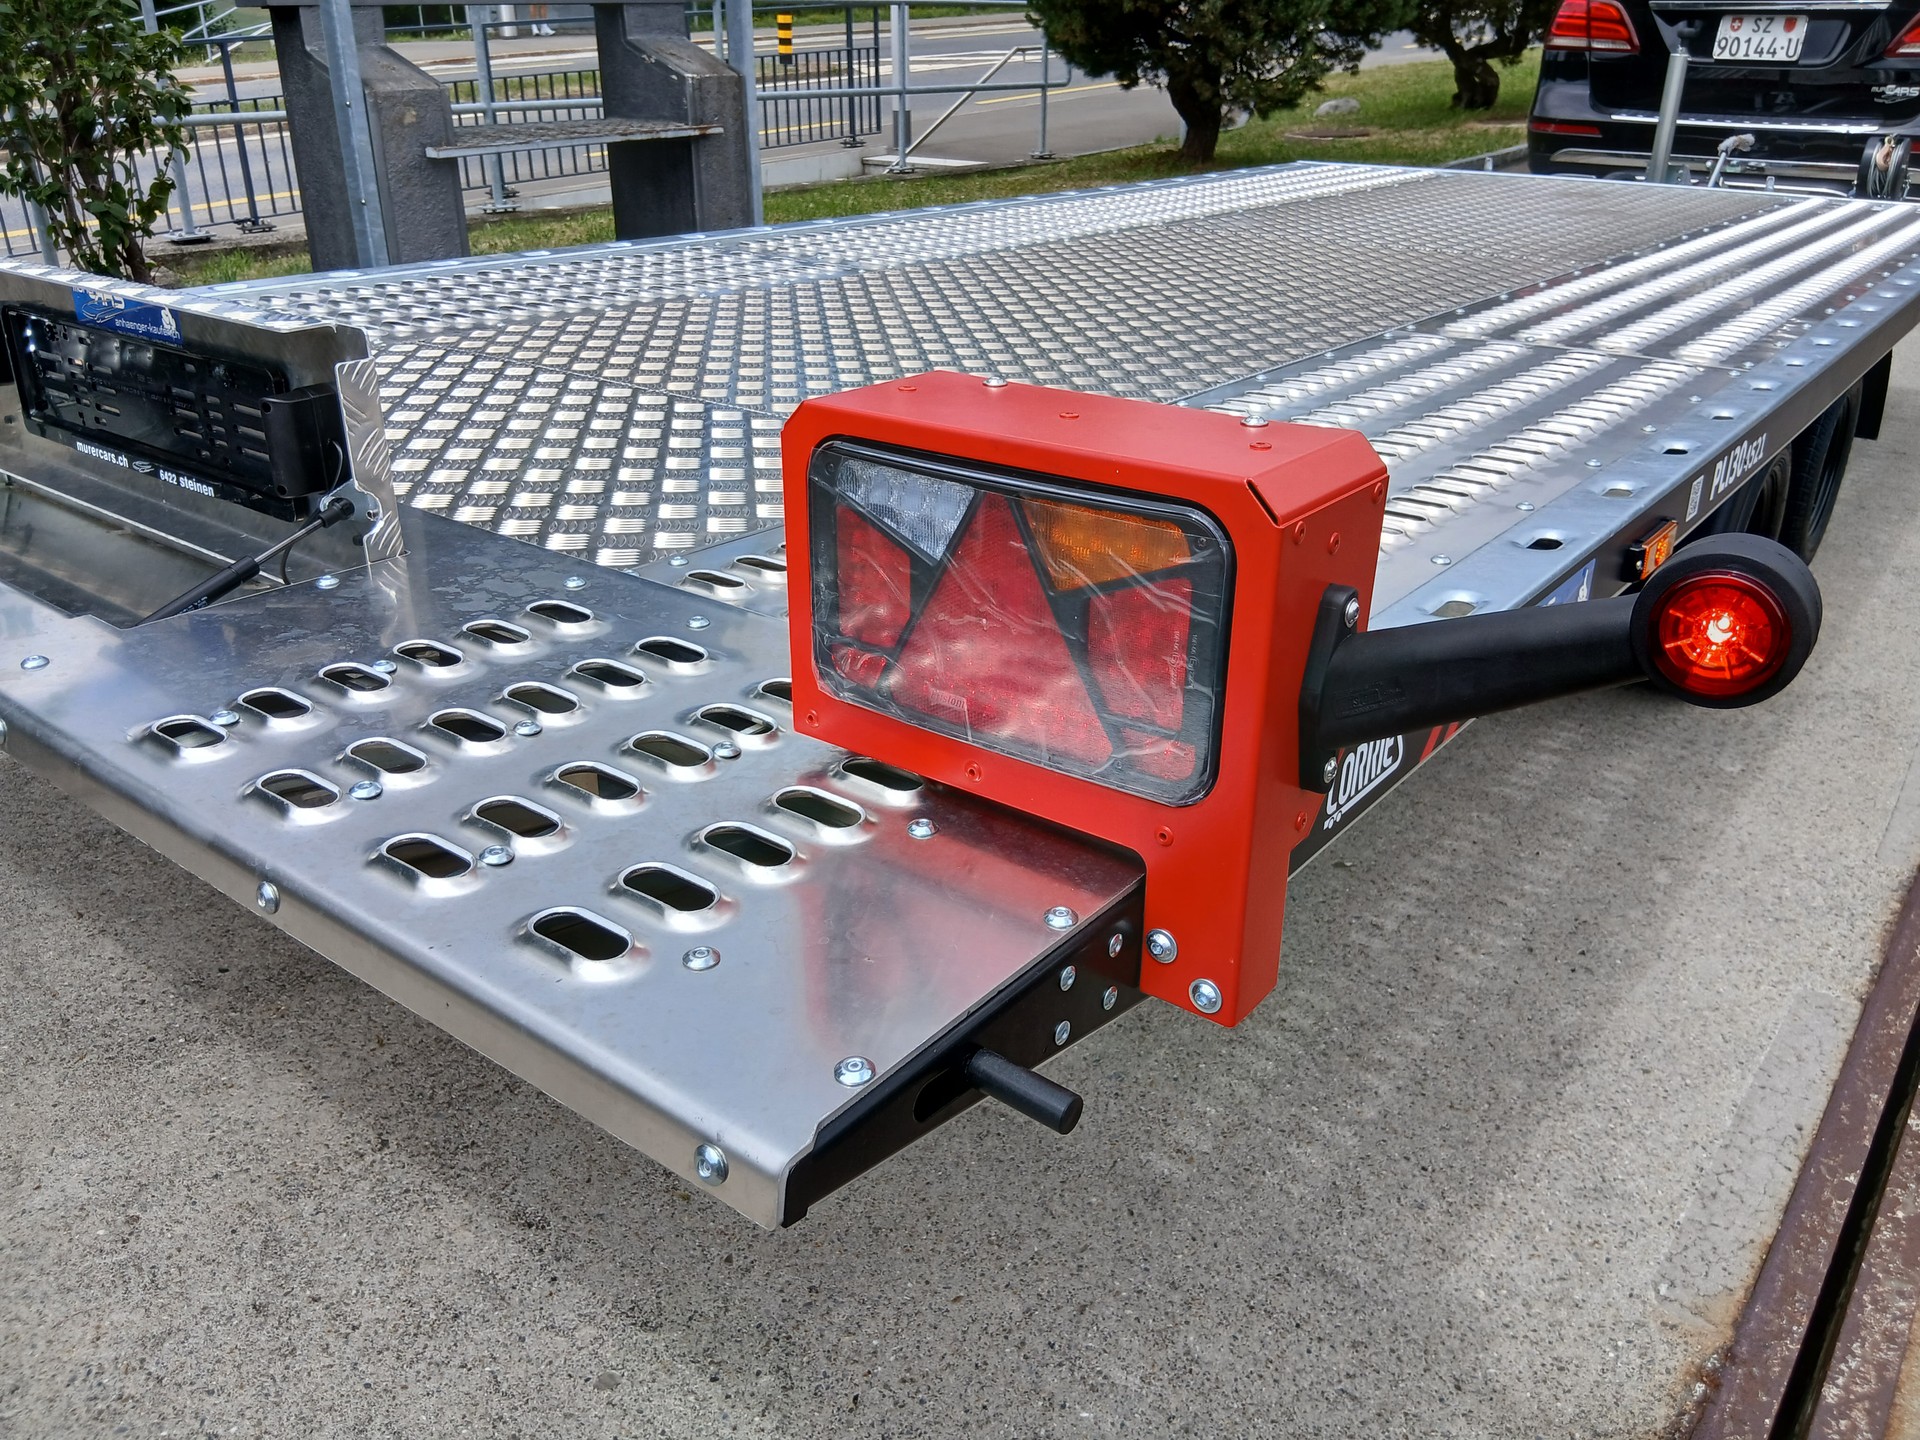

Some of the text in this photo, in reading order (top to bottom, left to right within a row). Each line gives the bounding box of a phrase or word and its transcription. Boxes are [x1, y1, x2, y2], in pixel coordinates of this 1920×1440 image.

[1752, 17, 1775, 34] SZ
[76, 440, 129, 469] murercars.ch
[159, 469, 215, 498] 6422 steinen
